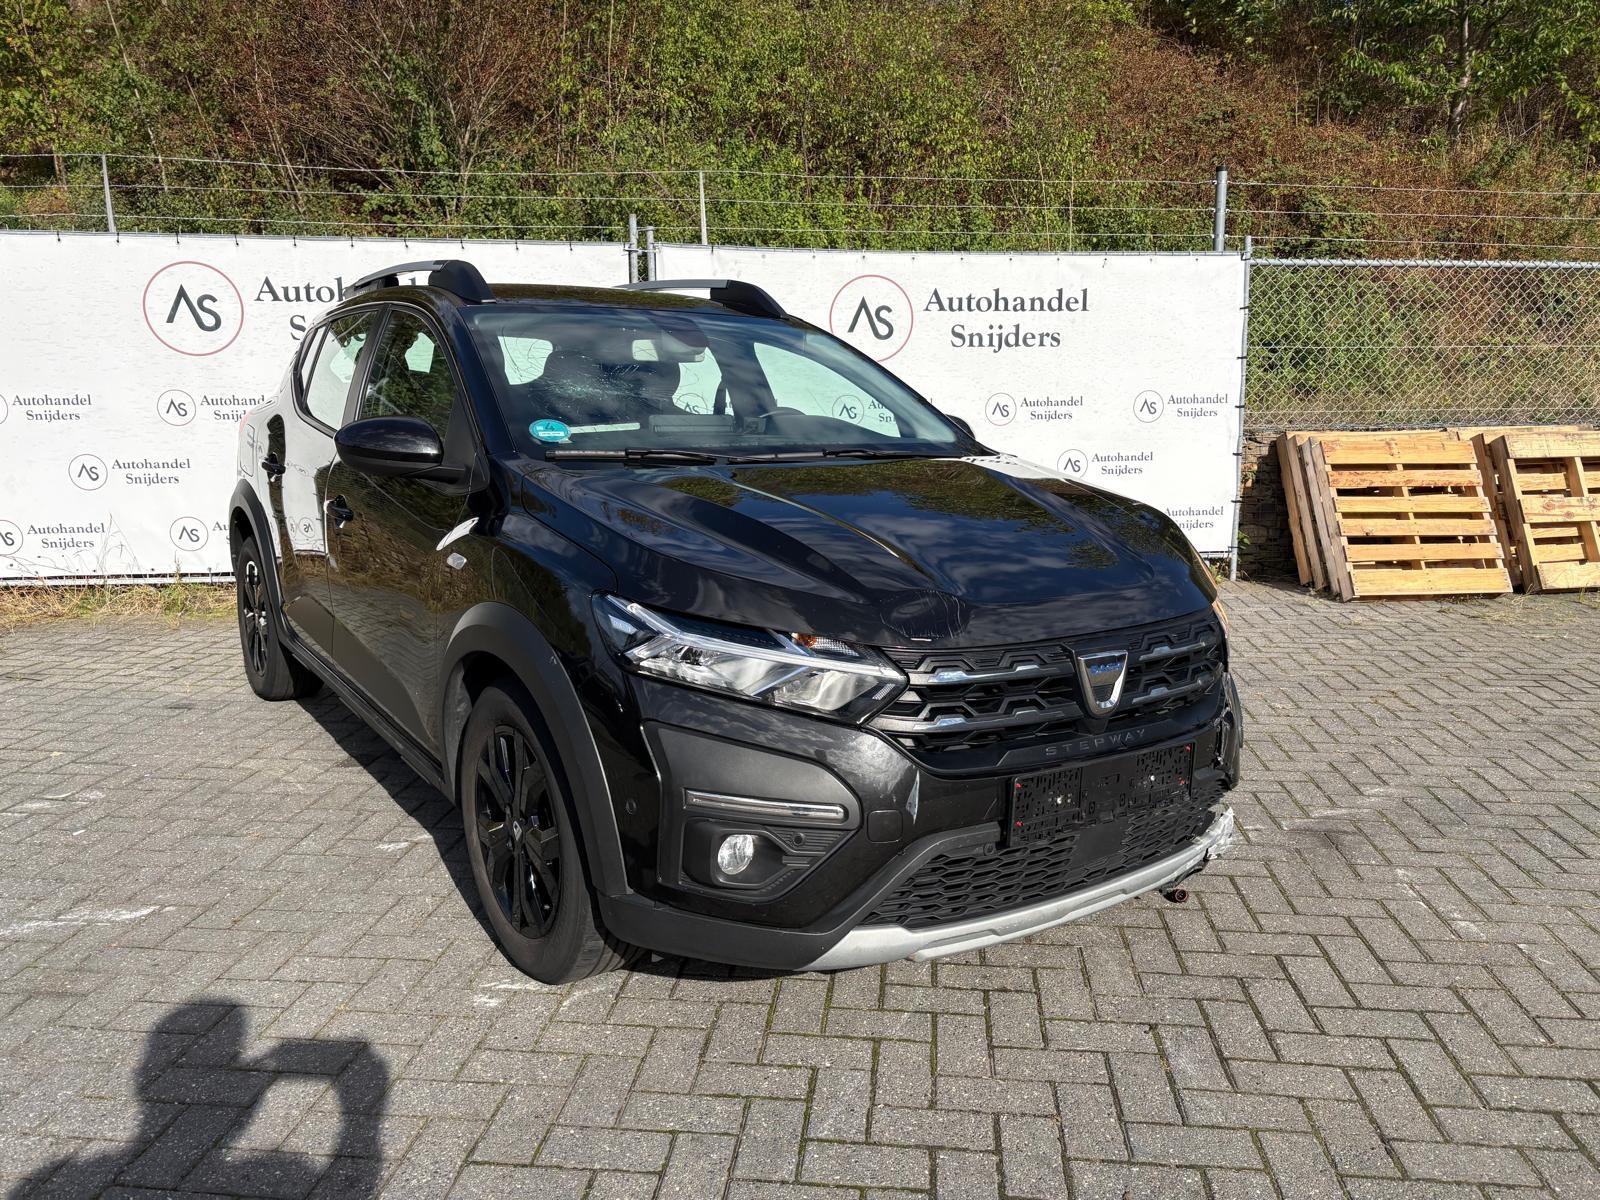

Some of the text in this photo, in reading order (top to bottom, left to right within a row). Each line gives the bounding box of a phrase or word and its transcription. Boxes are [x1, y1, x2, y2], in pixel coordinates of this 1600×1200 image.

[923, 288, 1089, 312] Autohandel
[951, 323, 1061, 353] Snijders
[12, 394, 92, 406] Autohandel
[200, 394, 265, 406] Autohand
[1020, 395, 1083, 407] Autohandel
[1167, 393, 1228, 405] Autohandel
[26, 410, 81, 423] Snijders
[1030, 410, 1073, 422] Snijders
[1176, 408, 1219, 419] Snijders
[1091, 451, 1154, 463] Autohandel
[111, 458, 191, 470] Autohandel
[1101, 465, 1144, 476] Snijders
[125, 473, 180, 486] Snijders
[1165, 505, 1224, 517] Autohandel
[27, 522, 106, 535] Autohandel
[1179, 519, 1214, 531] nijders
[41, 537, 95, 551] Snijders
[1045, 728, 1145, 756] STEPWAY
